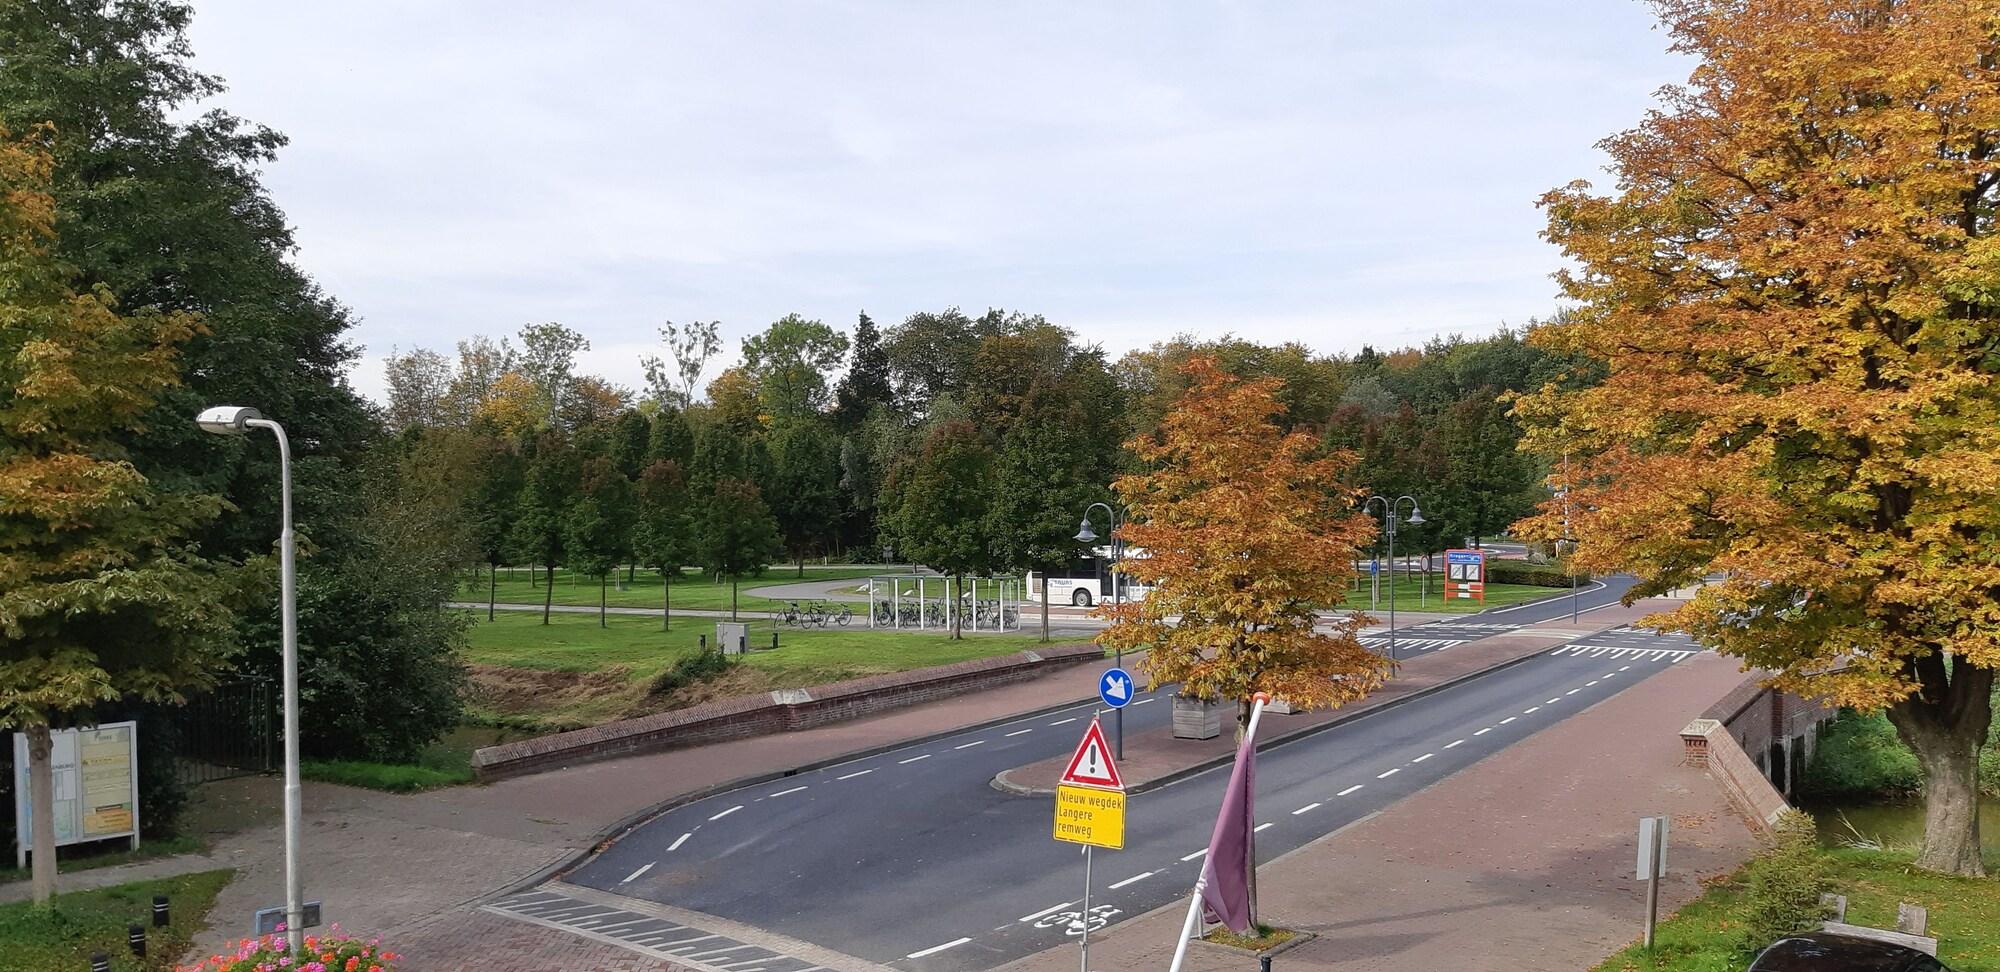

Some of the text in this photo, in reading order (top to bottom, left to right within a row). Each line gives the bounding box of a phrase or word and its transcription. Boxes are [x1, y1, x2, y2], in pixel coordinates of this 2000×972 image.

[1060, 791, 1122, 810] Nieuw wegdek
[1059, 806, 1093, 822] Langere
[1057, 823, 1092, 839] remweg
